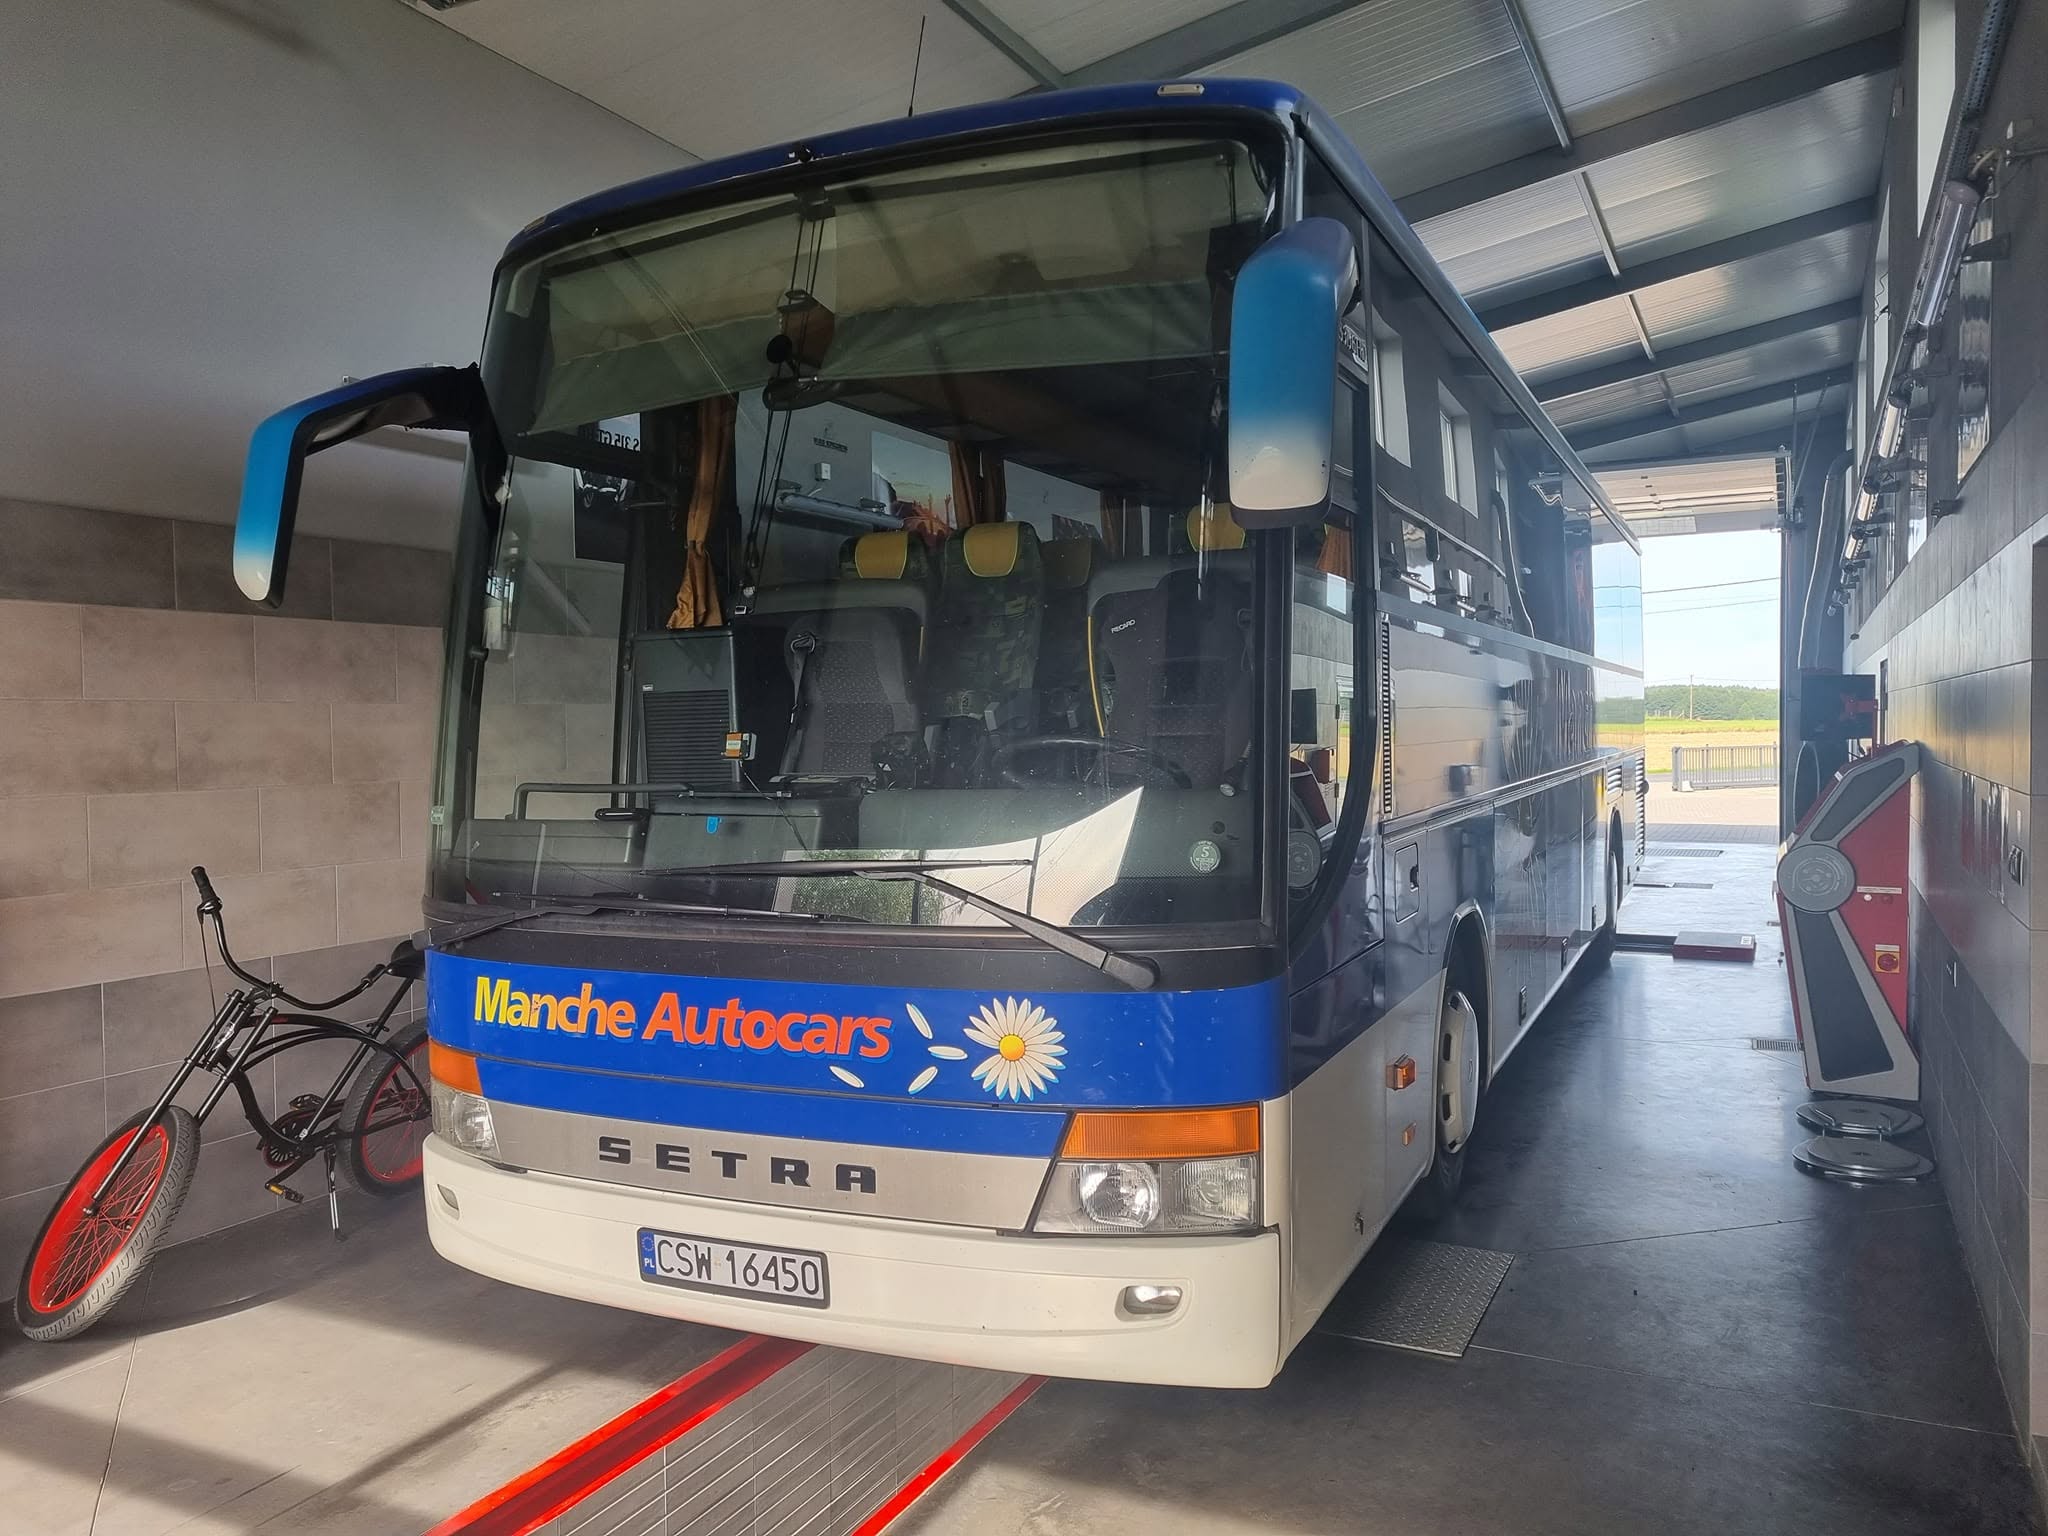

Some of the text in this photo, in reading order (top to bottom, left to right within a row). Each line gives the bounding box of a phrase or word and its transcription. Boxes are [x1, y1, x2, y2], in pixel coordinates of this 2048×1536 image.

[1111, 620, 1136, 633] RECARO
[473, 975, 894, 1060] Manche Autocars
[598, 1135, 878, 1194] SETRA
[644, 1257, 655, 1268] PL
[657, 1239, 819, 1295] CSW 16450
